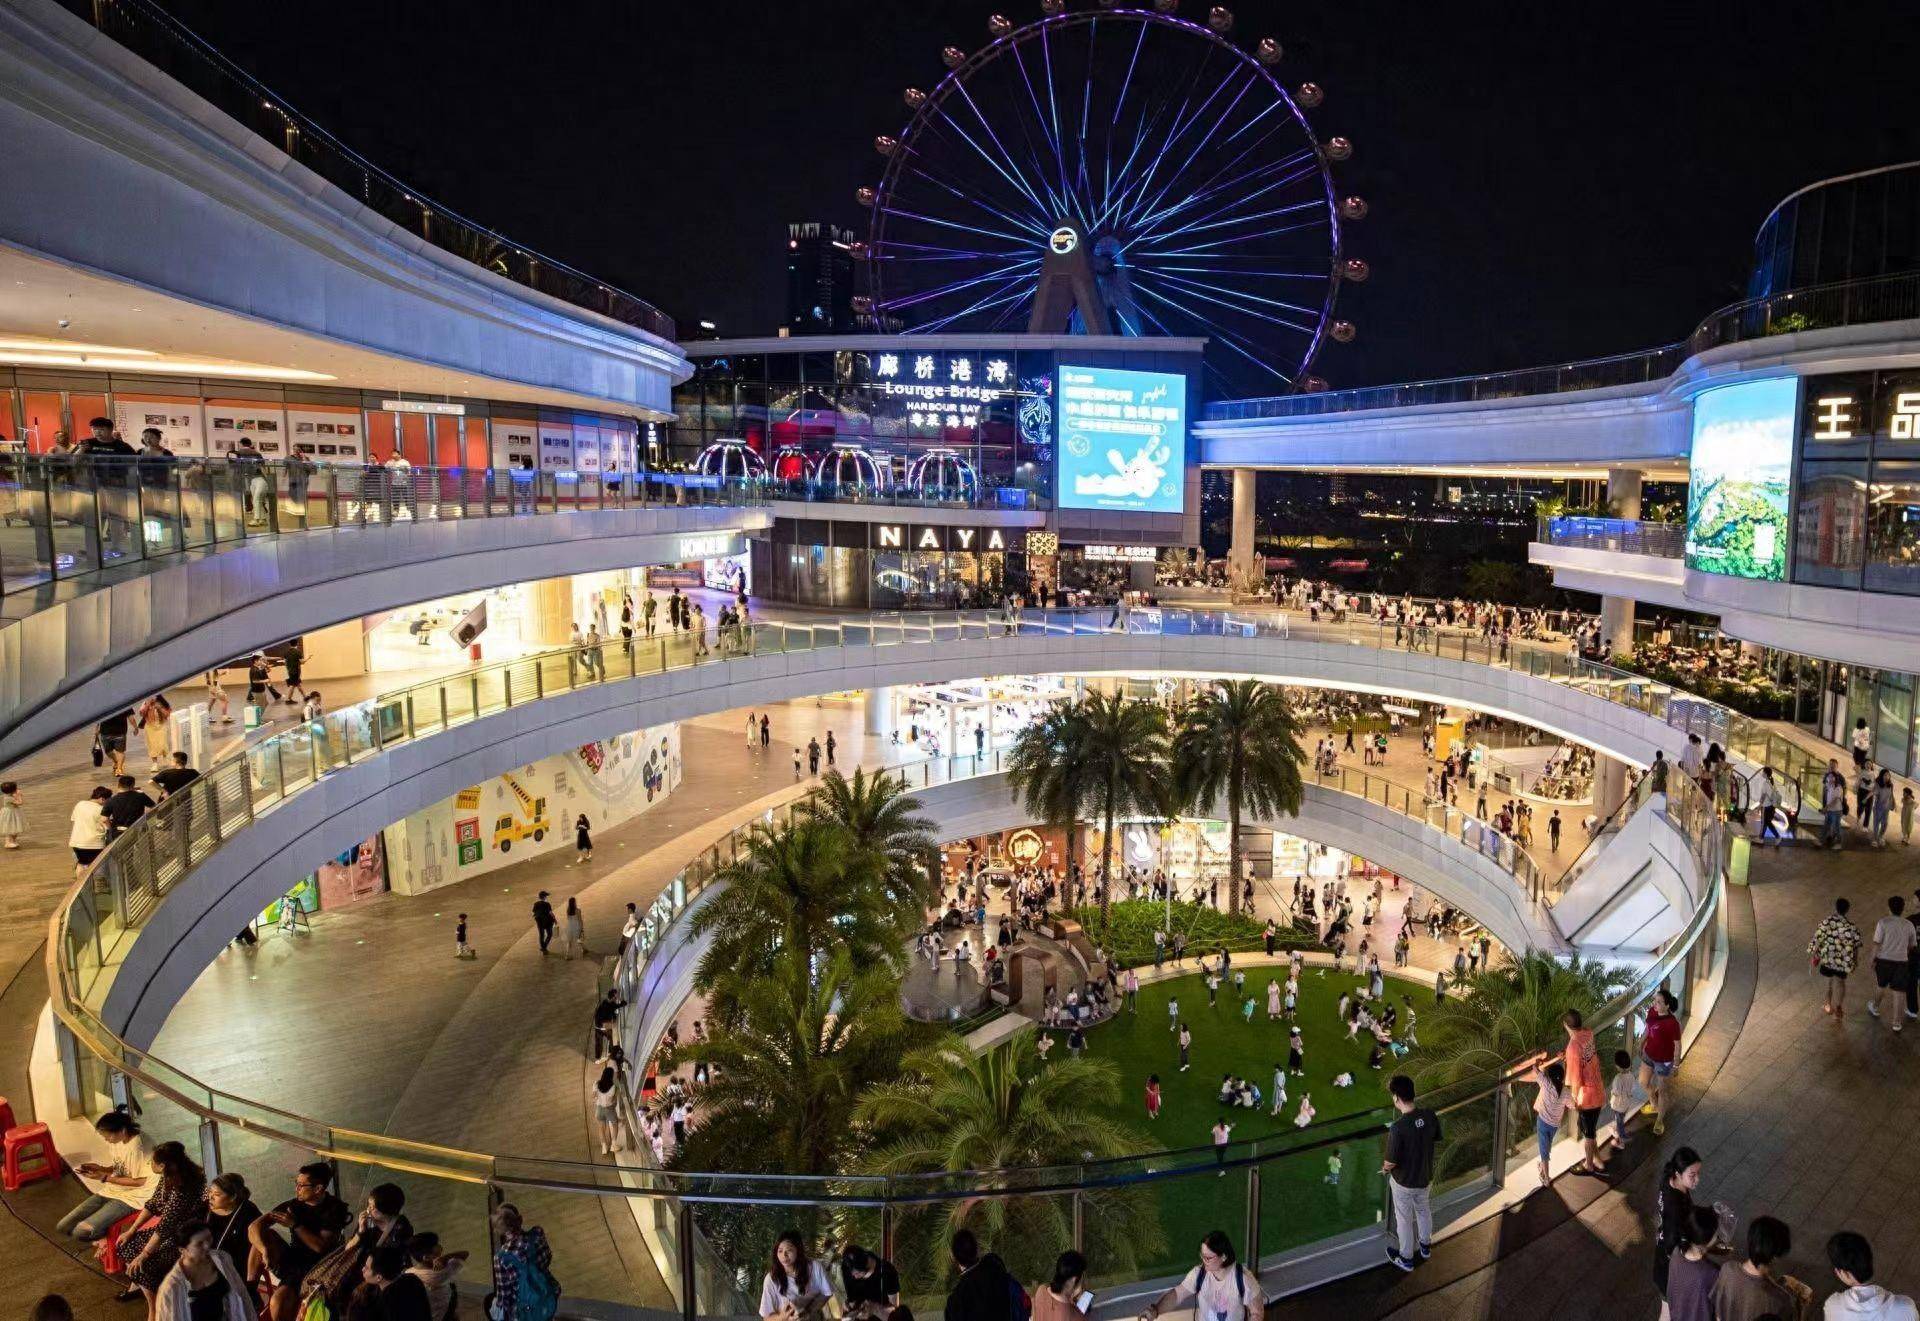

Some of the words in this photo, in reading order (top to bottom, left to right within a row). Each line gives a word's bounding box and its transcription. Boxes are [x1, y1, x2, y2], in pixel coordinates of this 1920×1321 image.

[885, 382, 944, 399] Lounge
[950, 384, 1000, 402] Bridge
[906, 401, 957, 412] HARBOUR
[960, 404, 981, 413] BAY
[879, 526, 1005, 549] NAYA
